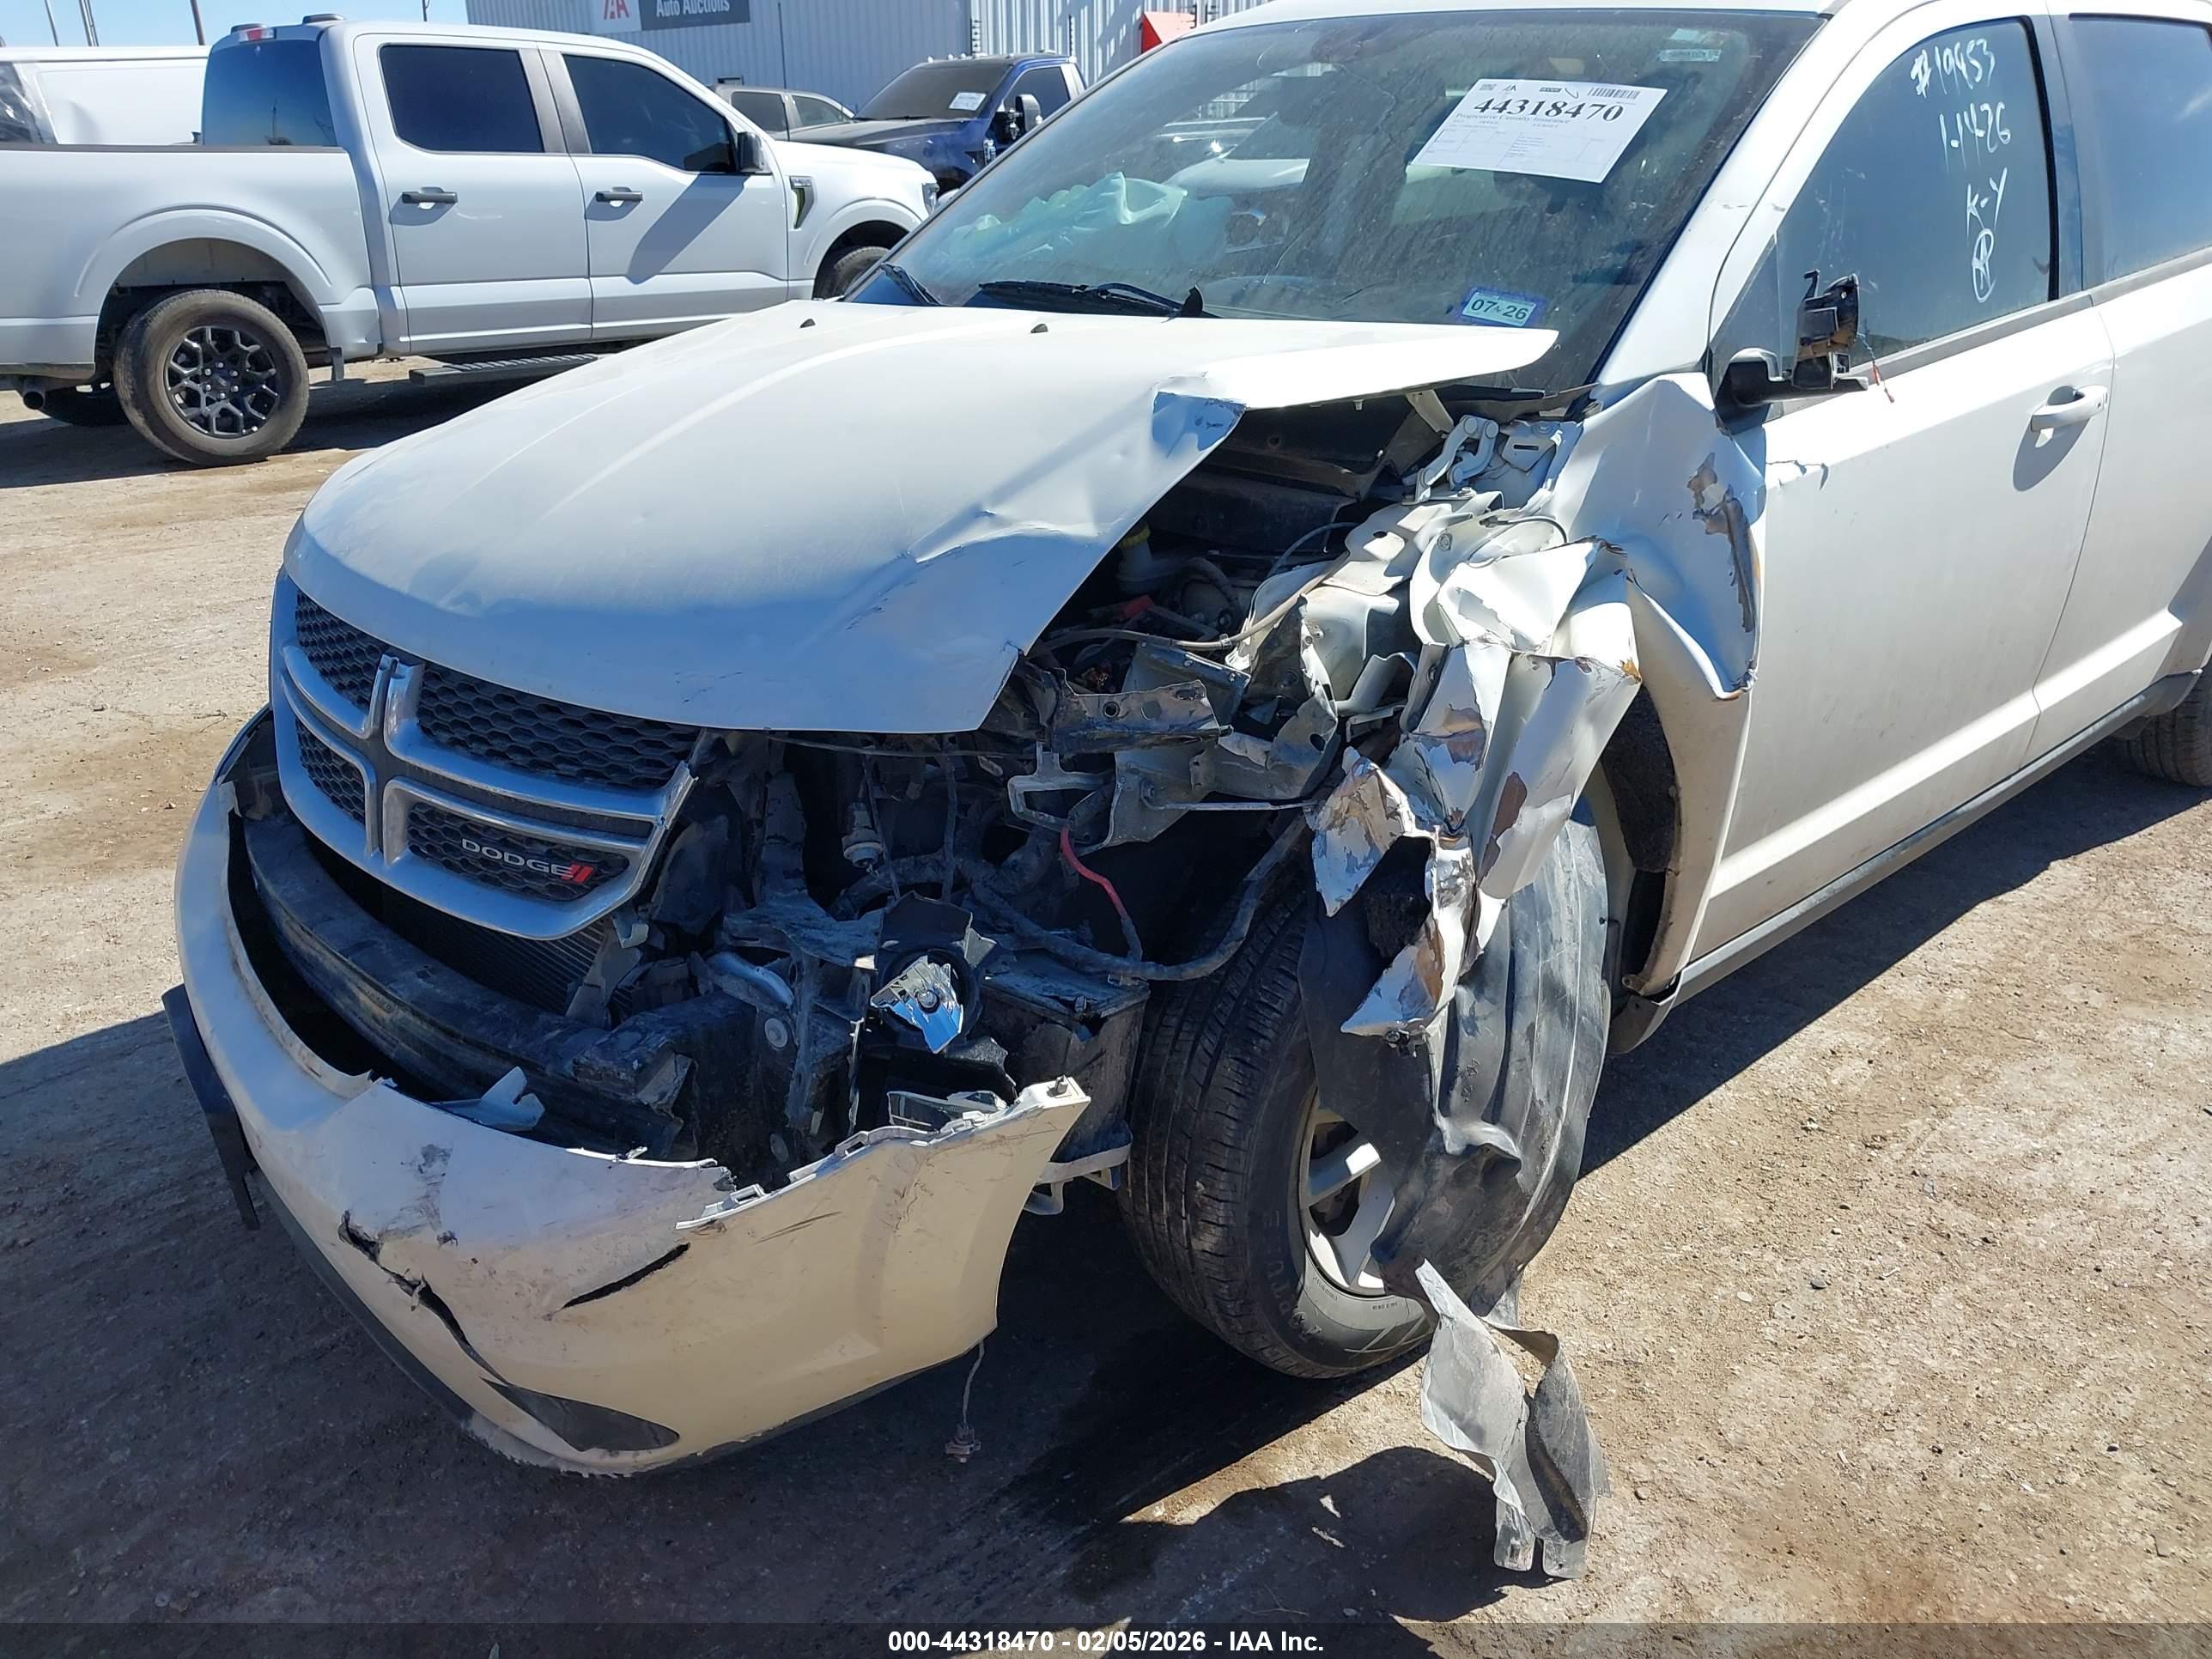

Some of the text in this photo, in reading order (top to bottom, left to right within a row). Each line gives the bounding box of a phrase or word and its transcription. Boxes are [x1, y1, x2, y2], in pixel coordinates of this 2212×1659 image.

[655, 0, 681, 18] Auto
[683, 0, 731, 15] Auctions
[1474, 97, 1624, 122] 44318470
[461, 838, 574, 878] DODGE
